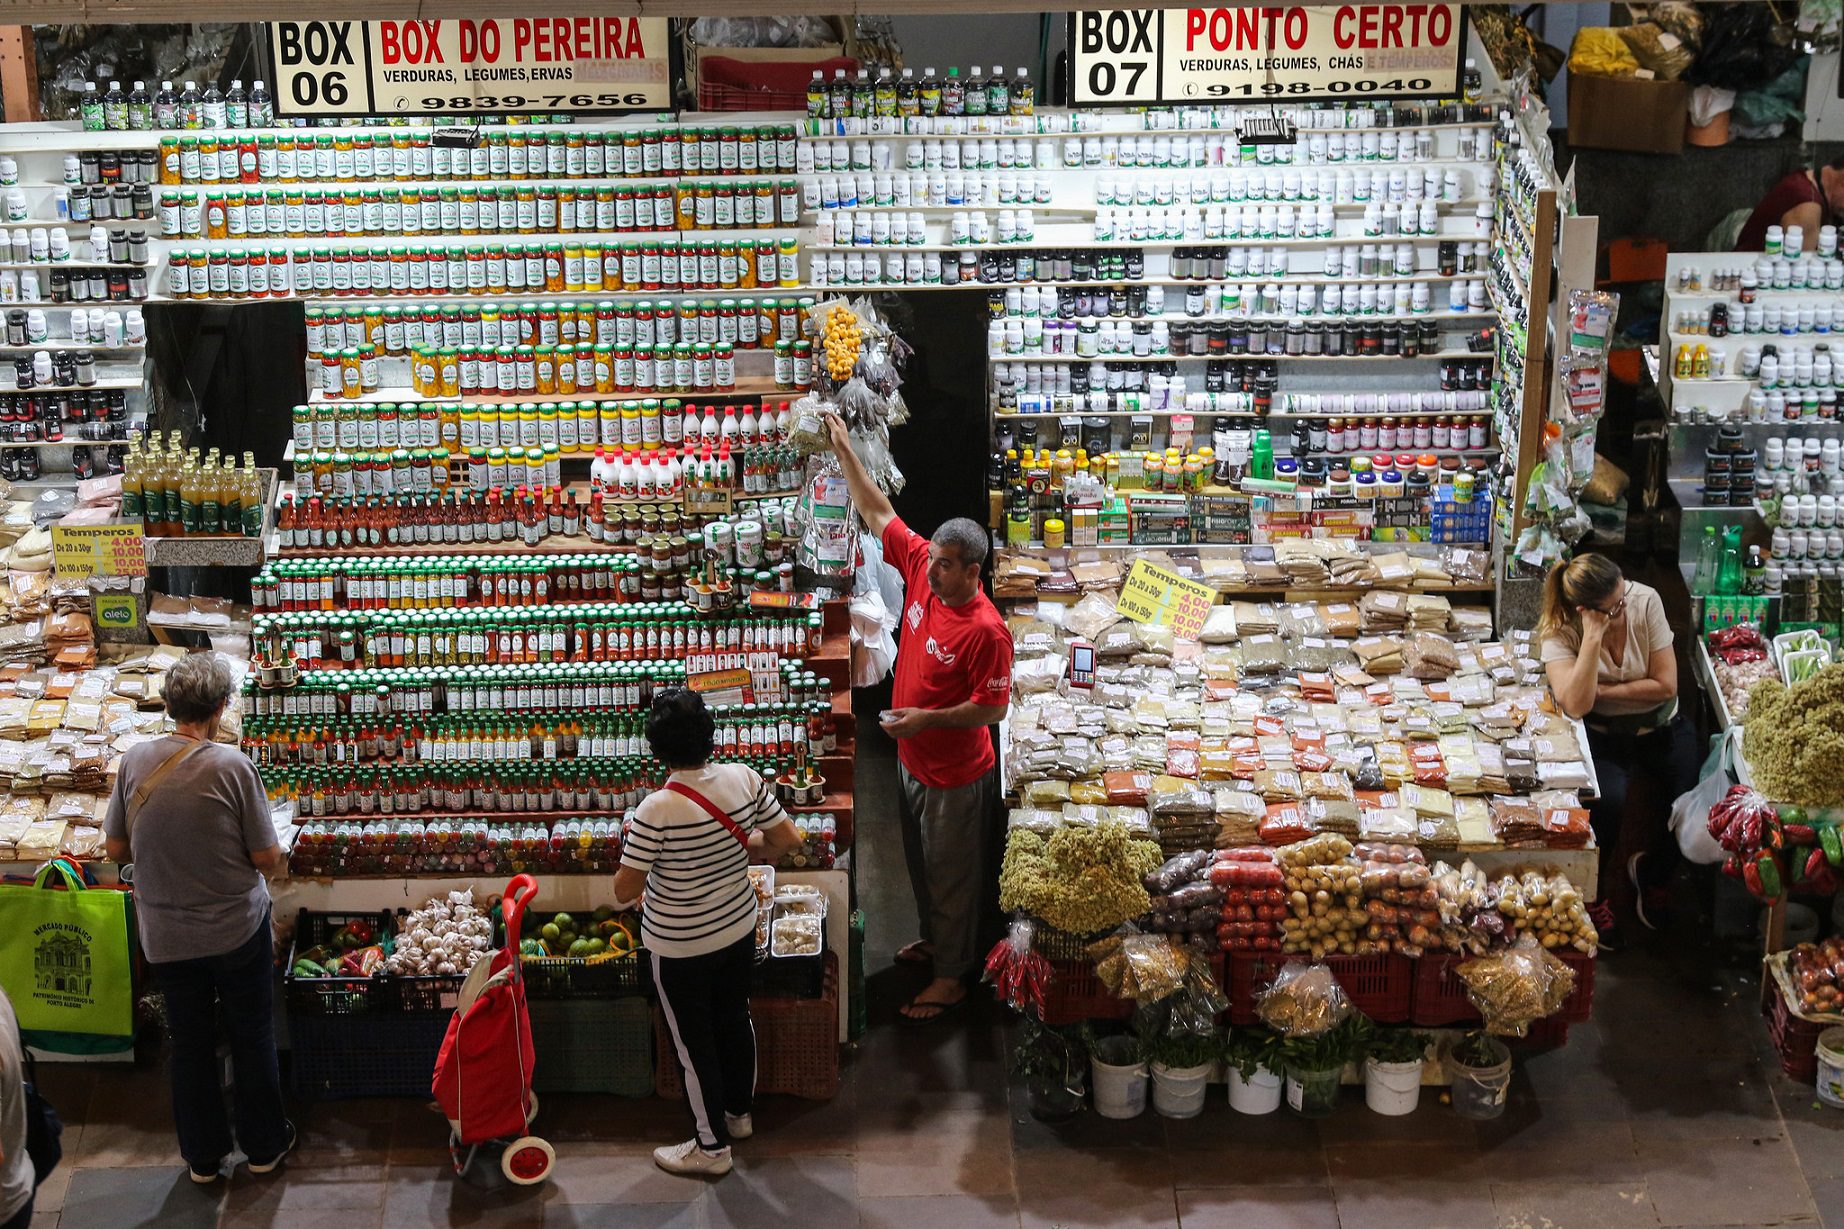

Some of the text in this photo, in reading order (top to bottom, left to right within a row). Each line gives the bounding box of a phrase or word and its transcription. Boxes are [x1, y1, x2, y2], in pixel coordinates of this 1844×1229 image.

[1081, 9, 1154, 54] BOX
[1186, 3, 1453, 52] PONTO CERTO
[280, 21, 355, 66] BOX
[380, 16, 646, 65] BOX DO PEREIRA
[1179, 58, 1253, 73] VERDURAS,
[1256, 57, 1321, 72] LEGUMES,
[1328, 53, 1364, 70] CHÁS
[382, 69, 458, 85] VERDURAS,
[464, 67, 531, 84] LEGUMES,
[530, 66, 573, 81] ERVAS
[1088, 62, 1149, 97] 07
[291, 71, 349, 106] 06
[1206, 78, 1432, 97] 9198-0040
[421, 93, 648, 110] 9839-7656
[60, 528, 134, 537] Temperos
[57, 544, 64, 552] De
[112, 537, 142, 547] 4,00
[112, 548, 143, 557] 10,00
[67, 564, 75, 572] 100
[114, 559, 144, 567] 10,00
[1129, 576, 1137, 587] De
[1136, 580, 1145, 590] 20
[1143, 564, 1207, 598] Temperos
[1120, 598, 1128, 608] De
[1127, 600, 1136, 612] 100
[1180, 593, 1211, 610] 4,00
[1178, 602, 1207, 620] 10,00
[1173, 613, 1201, 631] 10,00
[33, 922, 92, 942] MERCADO PÚBLICO
